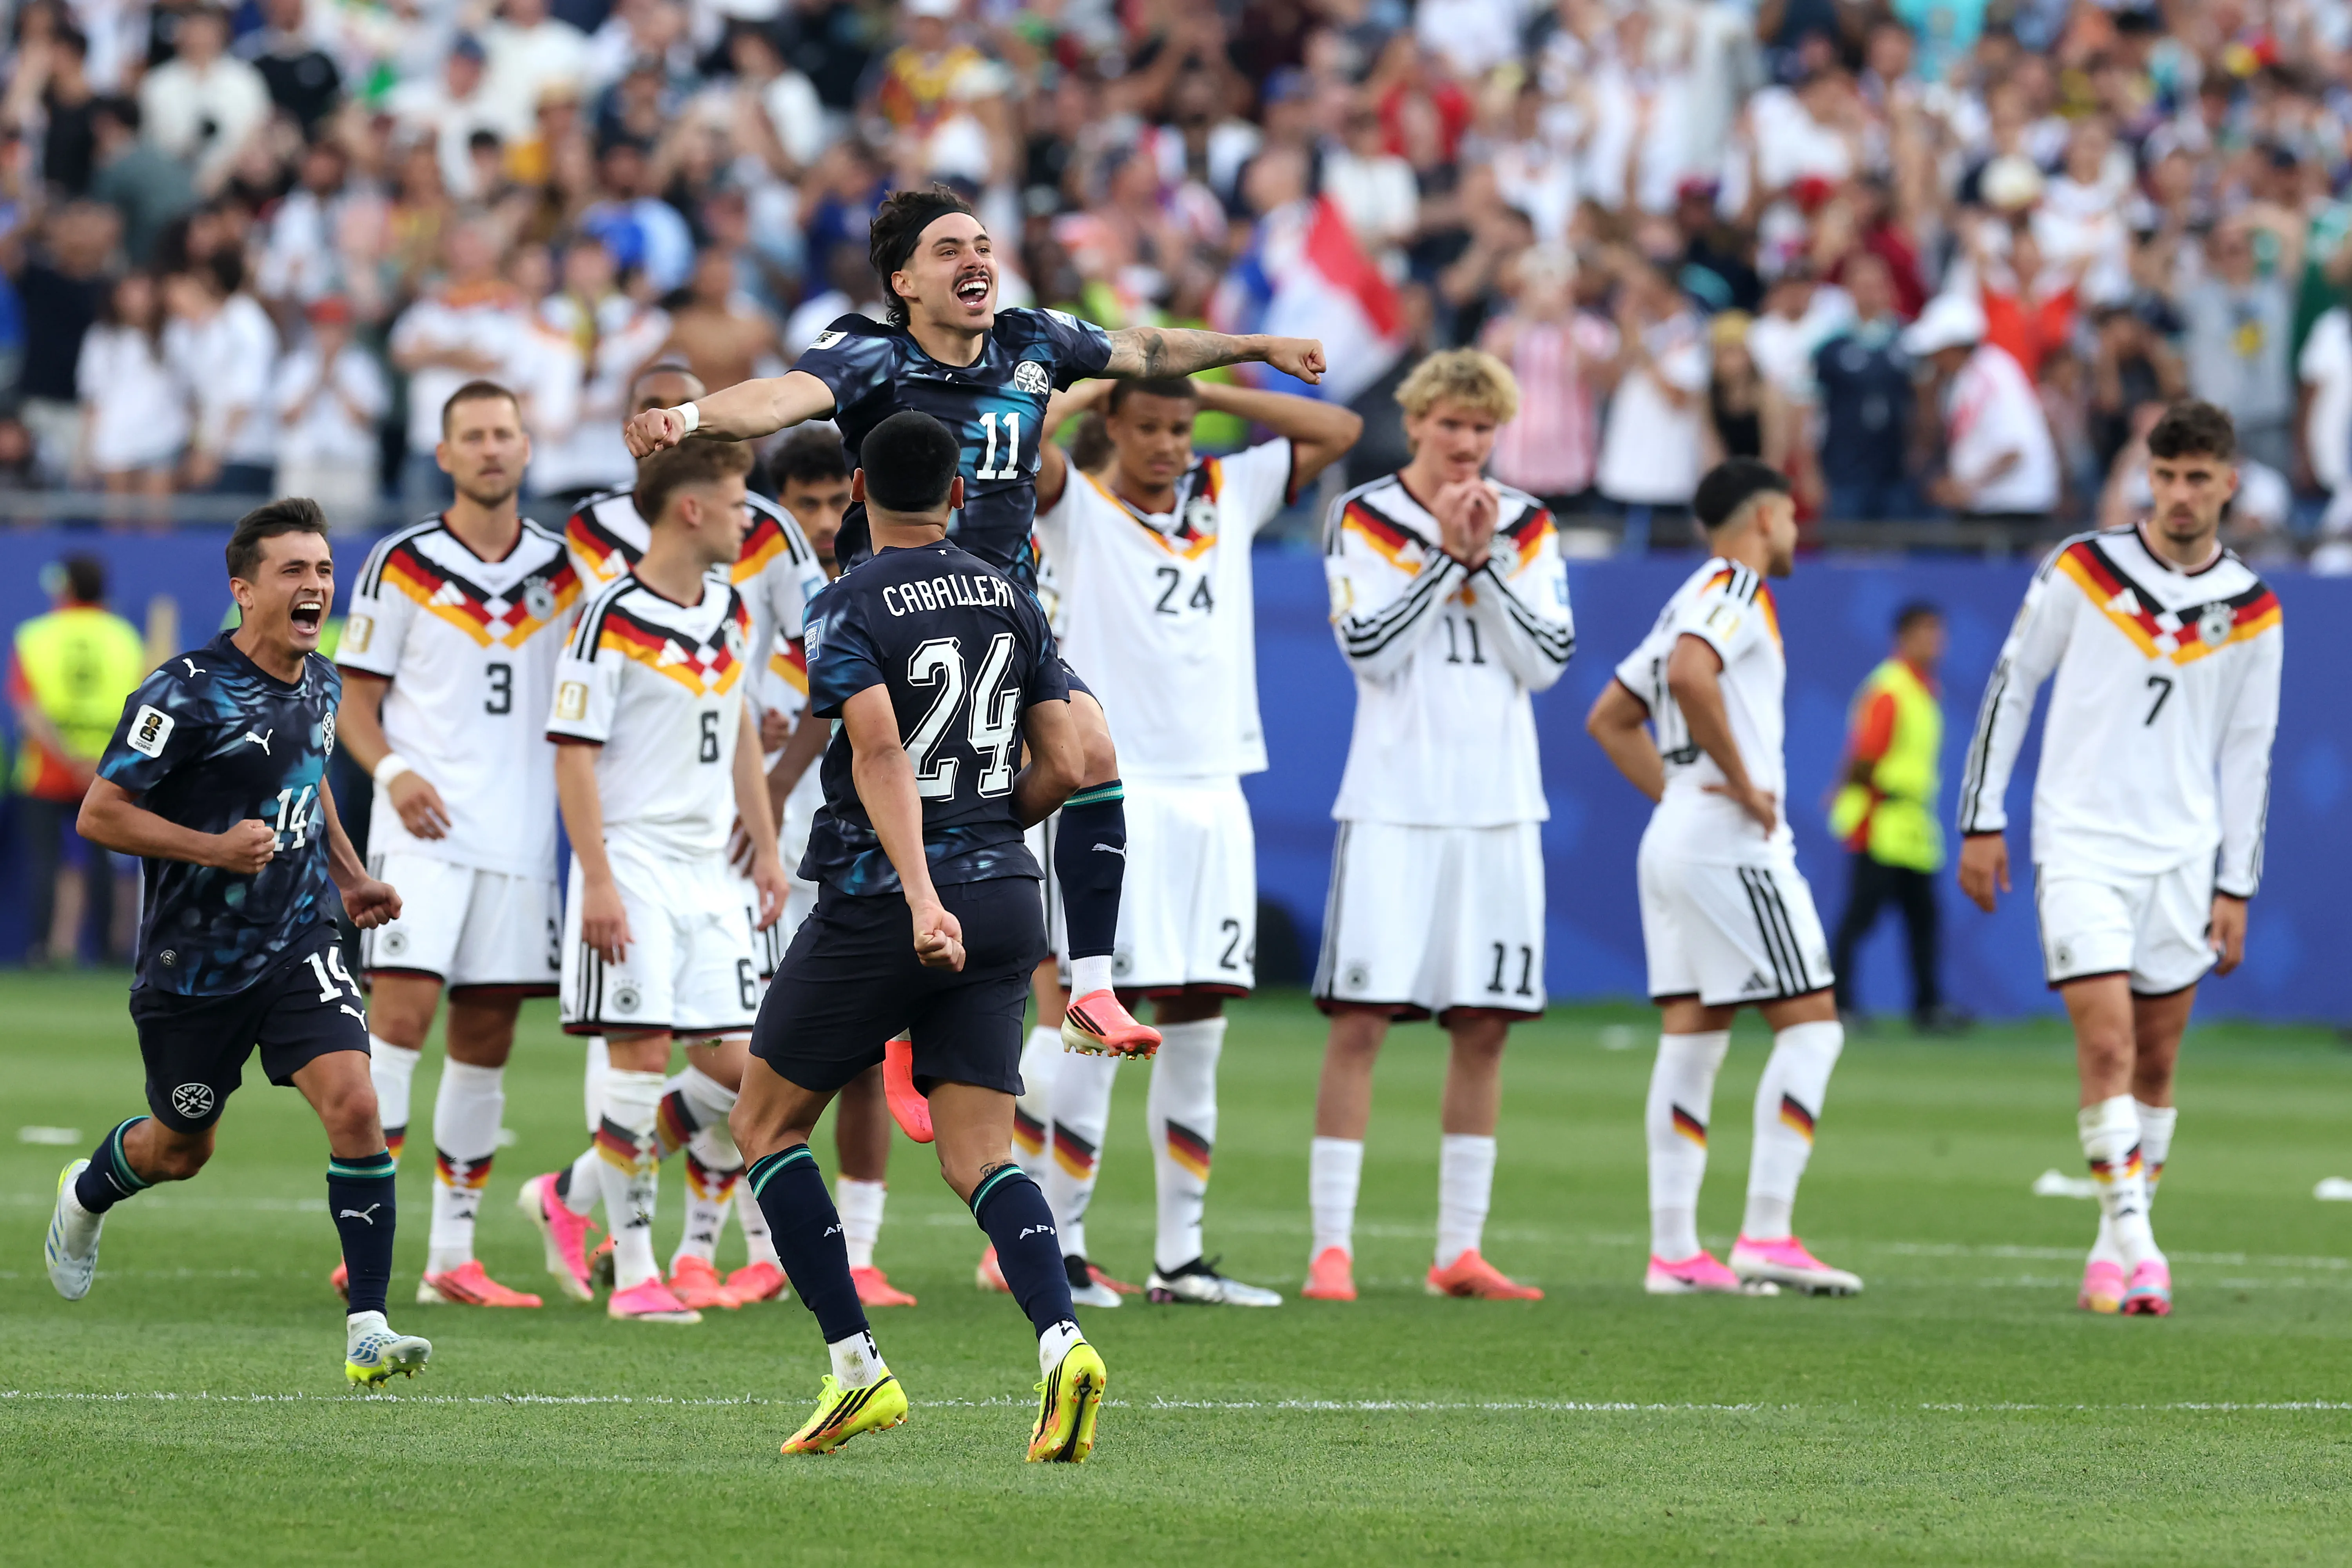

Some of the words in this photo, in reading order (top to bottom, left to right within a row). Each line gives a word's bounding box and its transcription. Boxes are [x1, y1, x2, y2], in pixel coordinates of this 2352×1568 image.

[976, 412, 1020, 479] 11
[1154, 566, 1215, 615] 24
[1444, 615, 1486, 664] 11
[485, 663, 513, 715] 3
[2143, 675, 2173, 727] 7
[699, 710, 719, 763] 6
[902, 632, 1020, 802] 24
[273, 785, 313, 851] 14
[302, 946, 362, 1003] 14
[737, 958, 756, 1010] 6
[1486, 941, 1532, 996] 11
